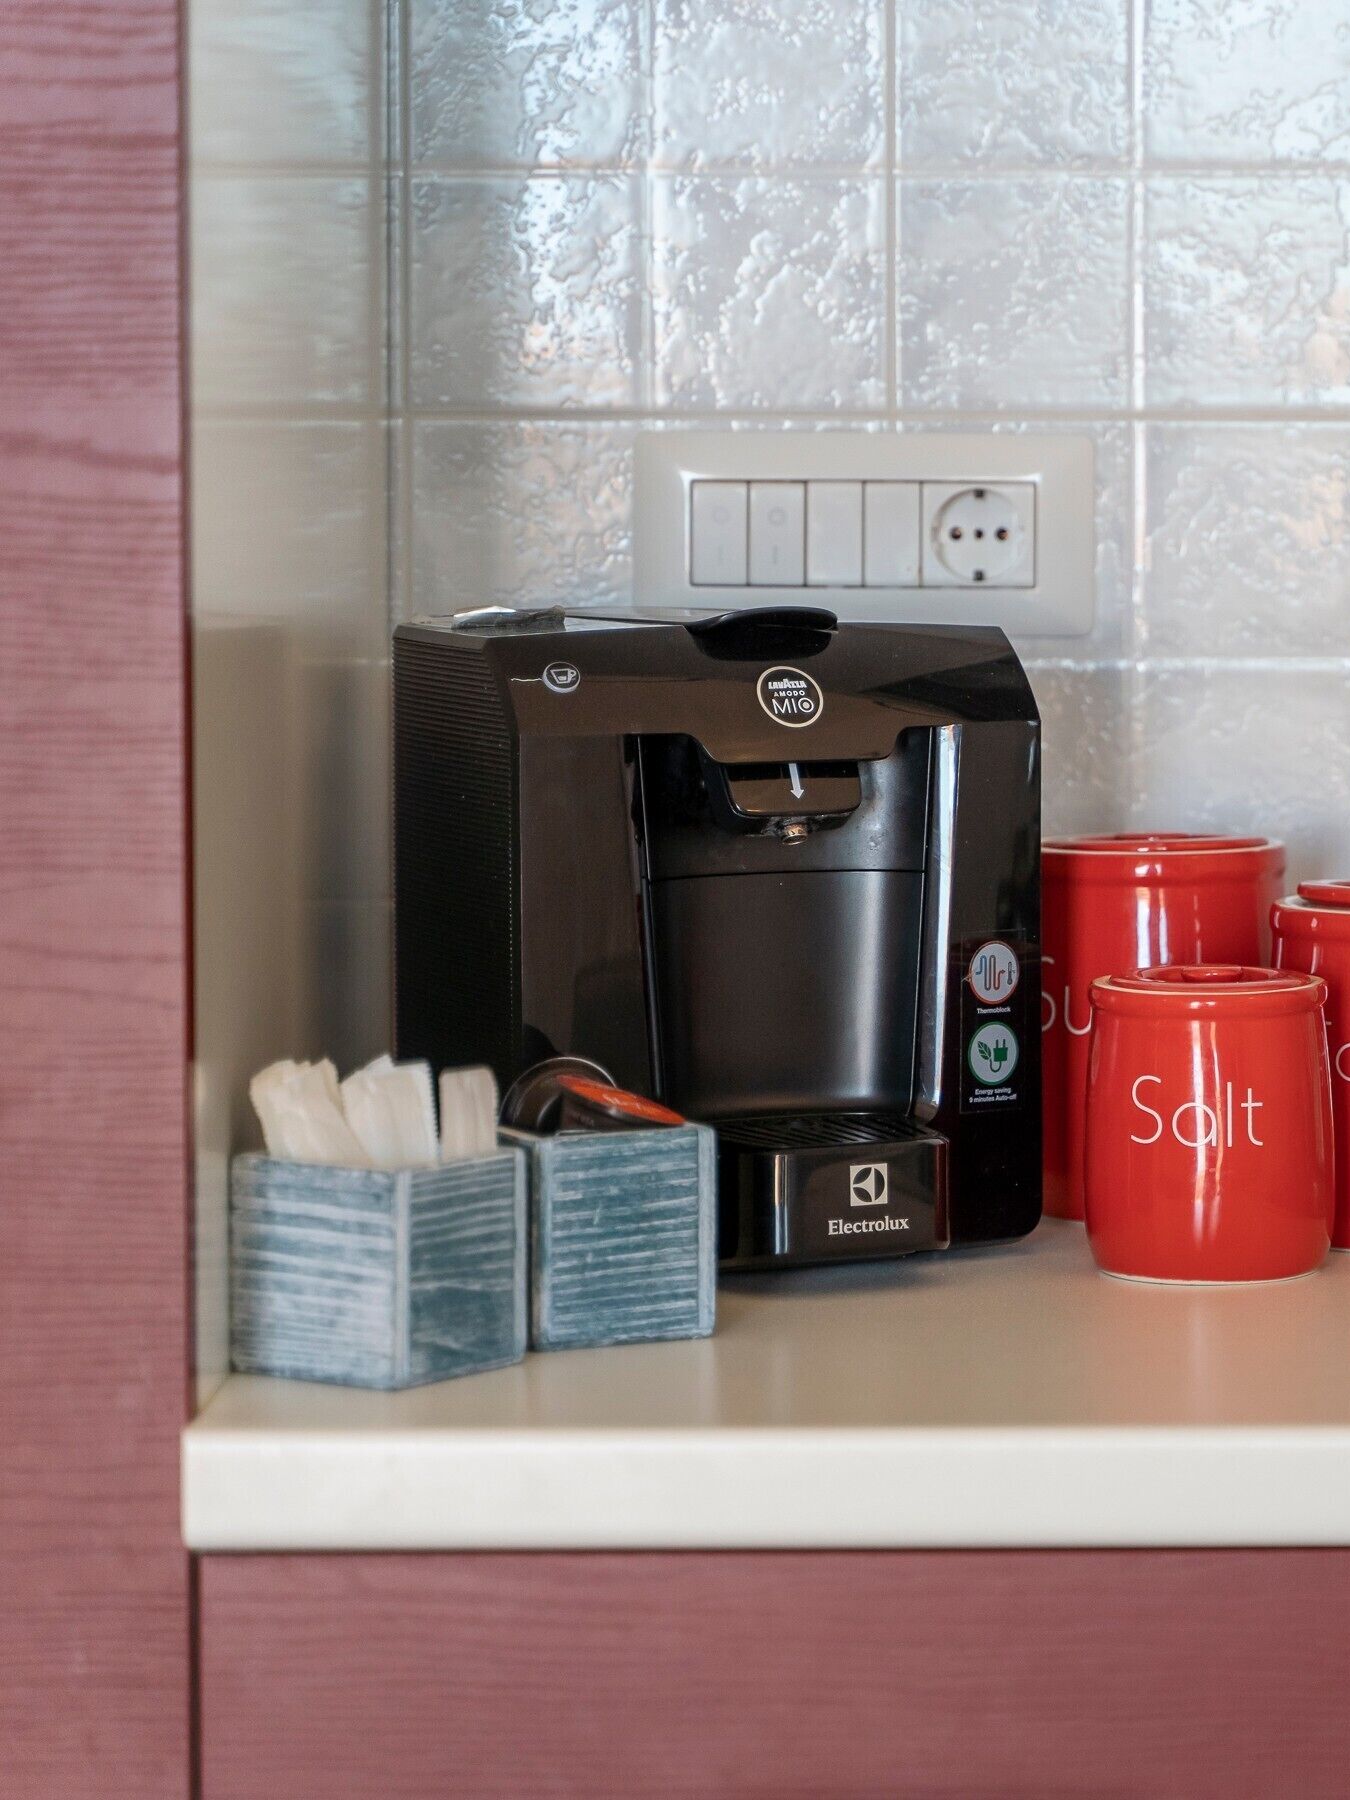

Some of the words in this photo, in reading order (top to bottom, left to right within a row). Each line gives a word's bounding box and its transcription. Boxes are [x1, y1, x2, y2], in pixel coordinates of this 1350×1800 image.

[768, 678, 807, 689] LAVAZZA
[771, 697, 815, 715] MIO
[976, 1006, 1011, 1014] Thermoblock
[974, 1088, 993, 1096] Energy
[1130, 1074, 1264, 1148] Salt
[827, 1216, 910, 1236] Electrolux
